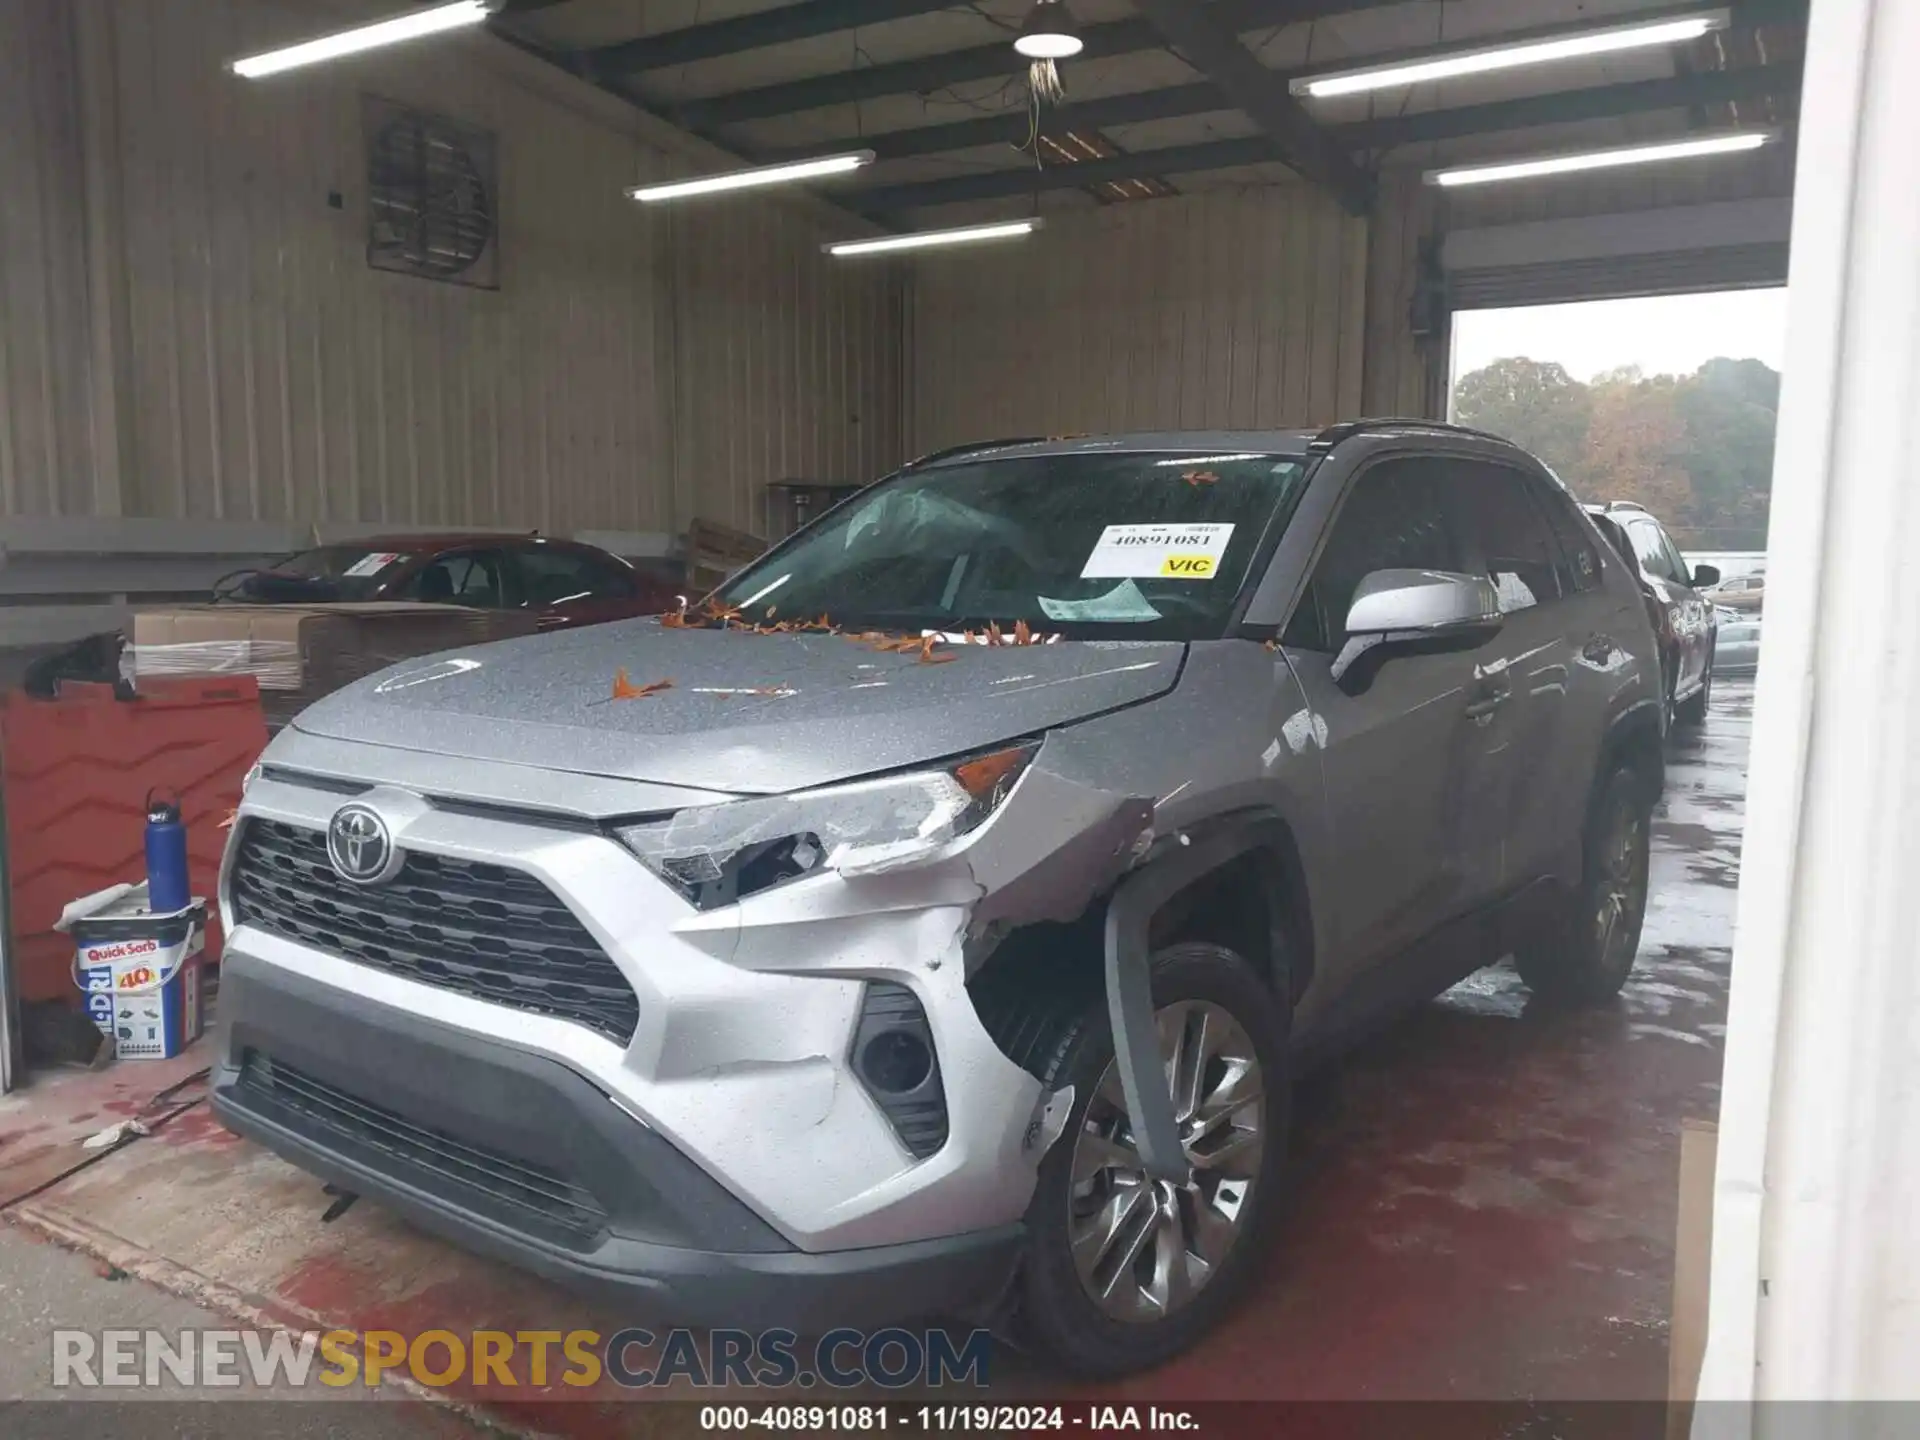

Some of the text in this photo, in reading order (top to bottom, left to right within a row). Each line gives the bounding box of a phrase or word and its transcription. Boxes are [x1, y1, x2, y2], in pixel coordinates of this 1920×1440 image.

[1112, 535, 1211, 546] 40891081
[1168, 559, 1210, 572] VIC
[88, 940, 157, 961] Quick Sorb
